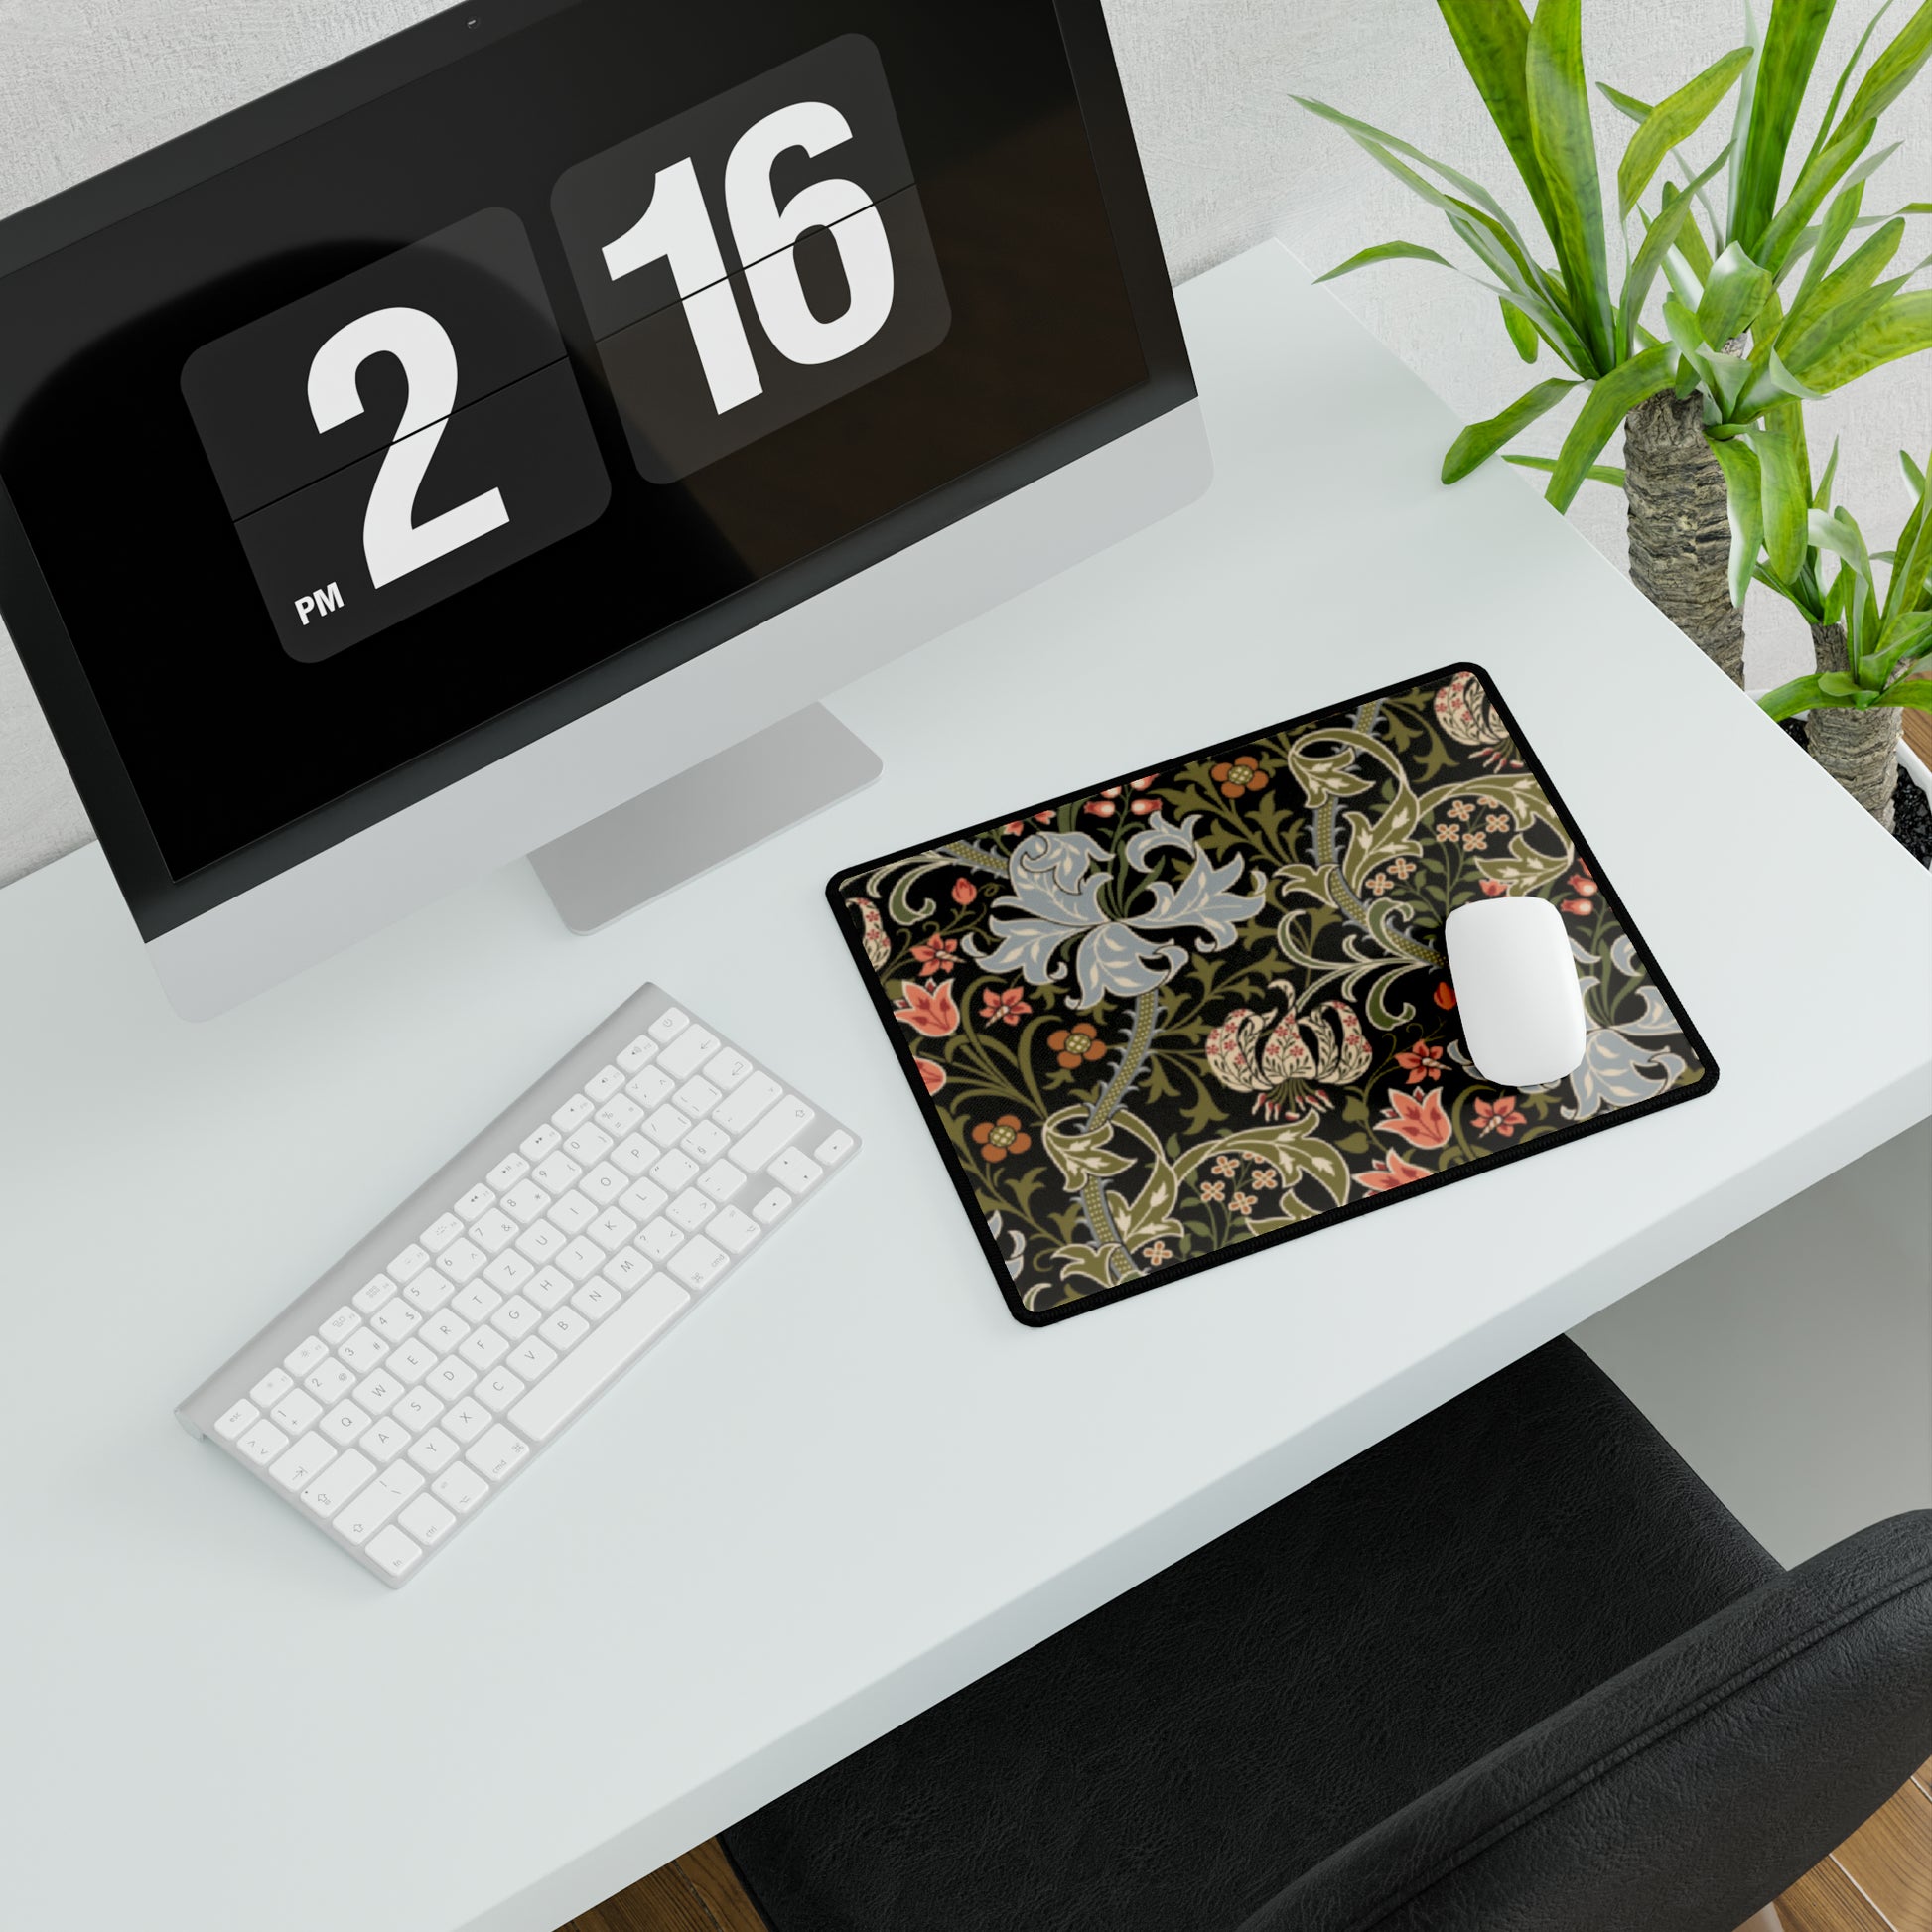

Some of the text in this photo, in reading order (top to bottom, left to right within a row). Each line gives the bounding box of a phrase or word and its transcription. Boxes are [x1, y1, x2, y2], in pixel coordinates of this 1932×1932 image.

[307, 101, 895, 590] 2 16
[294, 581, 345, 626] PM
[629, 1148, 640, 1159] P
[537, 1169, 548, 1178] 9
[505, 1197, 517, 1208] 8
[634, 1192, 648, 1202] L
[603, 1219, 617, 1231] K
[473, 1226, 483, 1237] 7
[534, 1234, 549, 1246] U
[574, 1250, 584, 1261] J
[443, 1257, 453, 1267] 6
[620, 1259, 635, 1273] M
[502, 1264, 517, 1277] Z
[539, 1279, 553, 1292] H
[409, 1286, 421, 1297] 5
[588, 1289, 603, 1303] N
[471, 1294, 483, 1305] T
[378, 1315, 388, 1325] 4
[507, 1309, 520, 1320] G
[438, 1324, 452, 1335] R
[556, 1320, 570, 1331] B
[475, 1339, 485, 1350] F
[344, 1346, 355, 1357] 3
[523, 1349, 536, 1360] V
[405, 1354, 419, 1366] E
[442, 1369, 455, 1382] D
[310, 1377, 323, 1388] 2
[491, 1380, 505, 1392] C
[370, 1383, 387, 1398] W
[409, 1400, 422, 1412] S
[340, 1416, 353, 1428] Q
[458, 1411, 473, 1424] X
[377, 1432, 390, 1444] A
[425, 1442, 437, 1452] Y
